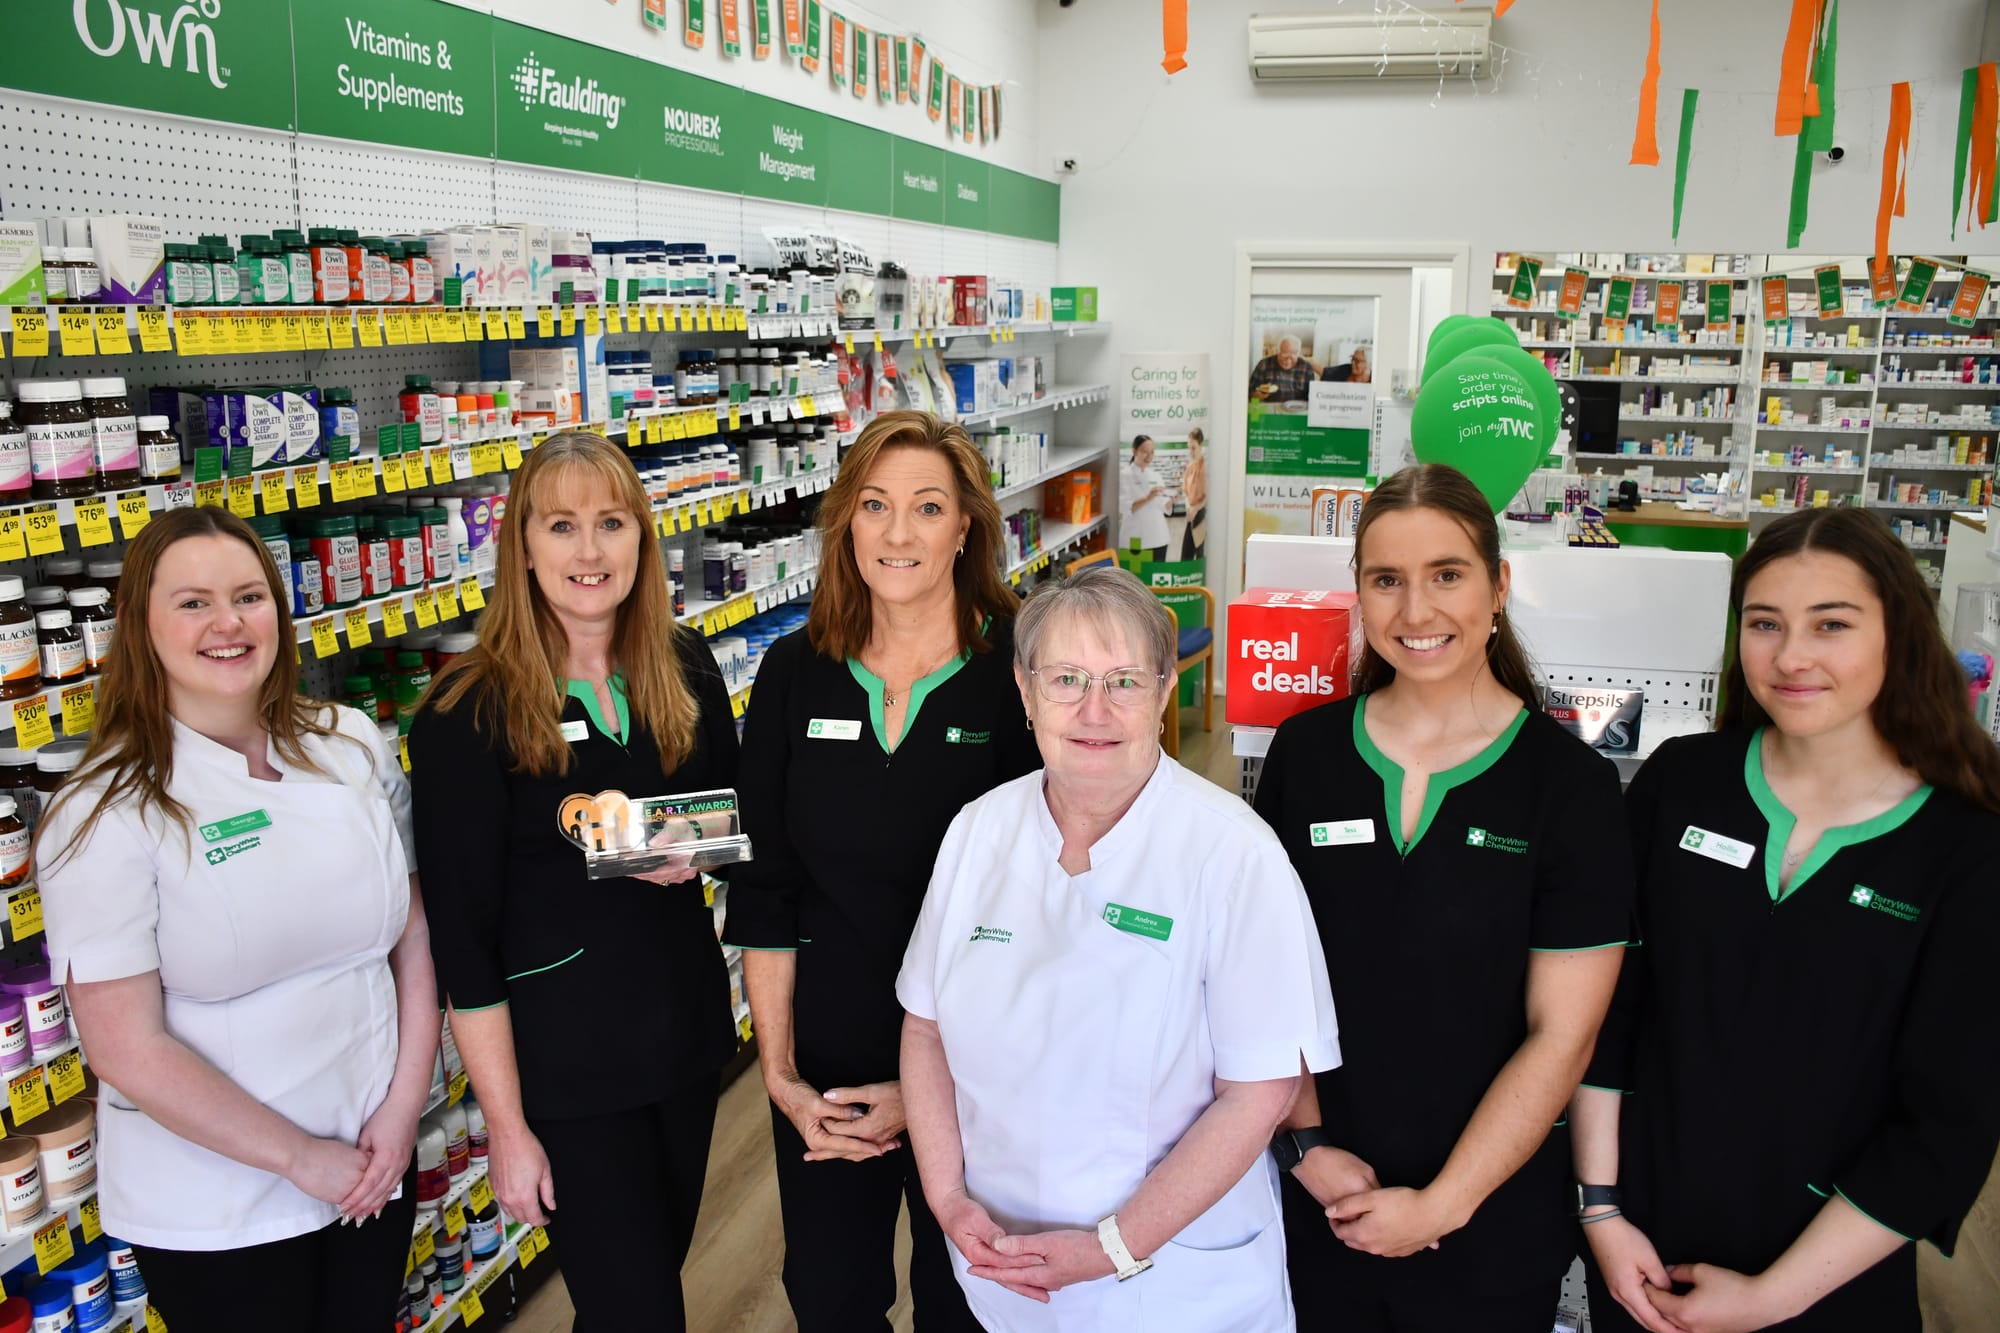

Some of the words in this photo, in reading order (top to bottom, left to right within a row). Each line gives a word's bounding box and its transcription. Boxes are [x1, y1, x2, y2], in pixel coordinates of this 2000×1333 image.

[345, 17, 431, 66] Vitamins
[437, 40, 452, 71] &
[337, 64, 464, 116] Supplements
[540, 67, 621, 129] Faulding
[664, 106, 721, 140] NOUREX
[664, 132, 722, 156] PROFESSIONAL
[772, 124, 804, 154] Weight
[759, 152, 816, 181] Management
[1131, 367, 1178, 385] Caring
[1182, 366, 1198, 381] for
[1457, 372, 1489, 385] Save
[1131, 386, 1183, 401] families
[1186, 385, 1201, 400] for
[1461, 382, 1496, 395] order
[1499, 383, 1524, 395] your
[1452, 394, 1498, 411] scripts
[1501, 394, 1534, 411] online
[253, 416, 281, 426] COMPLETE
[288, 413, 315, 424] COMPLETE
[1131, 408, 1162, 420] over
[1167, 405, 1184, 419] 60
[254, 425, 270, 435] SLEEP
[288, 422, 305, 431] SLEEP
[1458, 423, 1482, 443] join
[255, 432, 280, 441] ADVANCED
[1326, 498, 1336, 536] Voltaren
[1241, 631, 1299, 662] real
[1251, 662, 1335, 696] deals
[1550, 691, 1625, 710] Strepsils
[688, 799, 734, 814] AWARDS
[1485, 832, 1529, 848] TerryWhite
[1485, 841, 1527, 854] Chemmart
